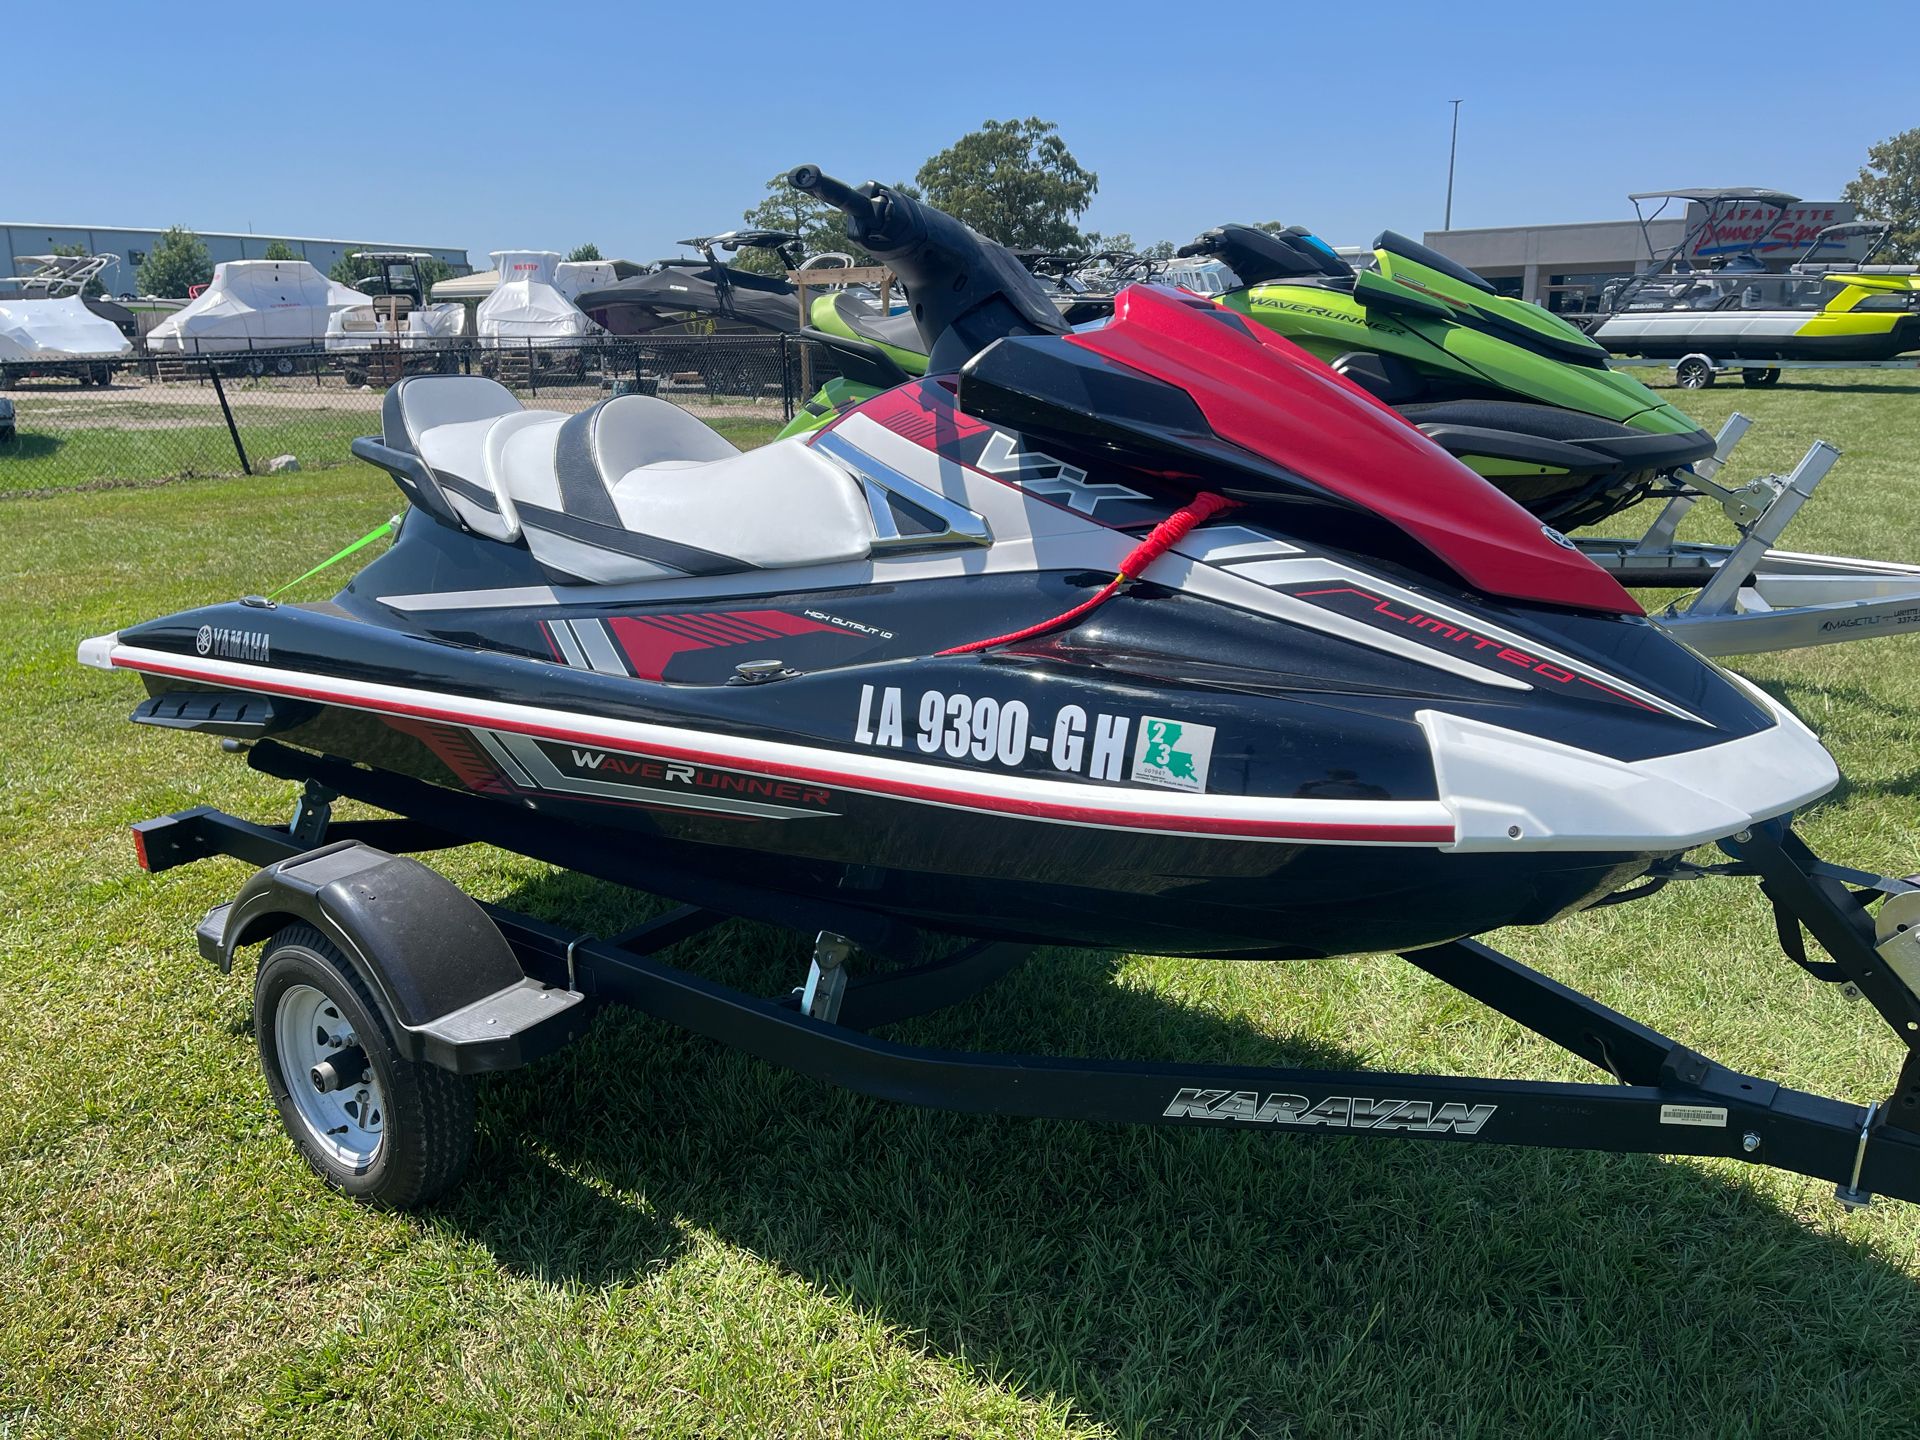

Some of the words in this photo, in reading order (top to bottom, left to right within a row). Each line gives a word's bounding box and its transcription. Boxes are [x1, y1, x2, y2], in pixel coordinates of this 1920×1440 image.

[1712, 208, 1836, 221] LAFAYETTE
[1250, 297, 1407, 336] WAVERUNNER
[976, 430, 1154, 516] VX
[804, 609, 831, 621] HIGH
[831, 616, 879, 634] OUTPUT
[213, 627, 270, 662] YAMAHA
[1374, 601, 1576, 683] LIMITED
[854, 684, 903, 747] LA
[916, 690, 1131, 782] 9390-GH
[1151, 723, 1167, 743] 2
[1156, 743, 1171, 765] 3
[571, 749, 831, 806] WAVERUNNER
[1162, 1088, 1498, 1135] KARAVAN
